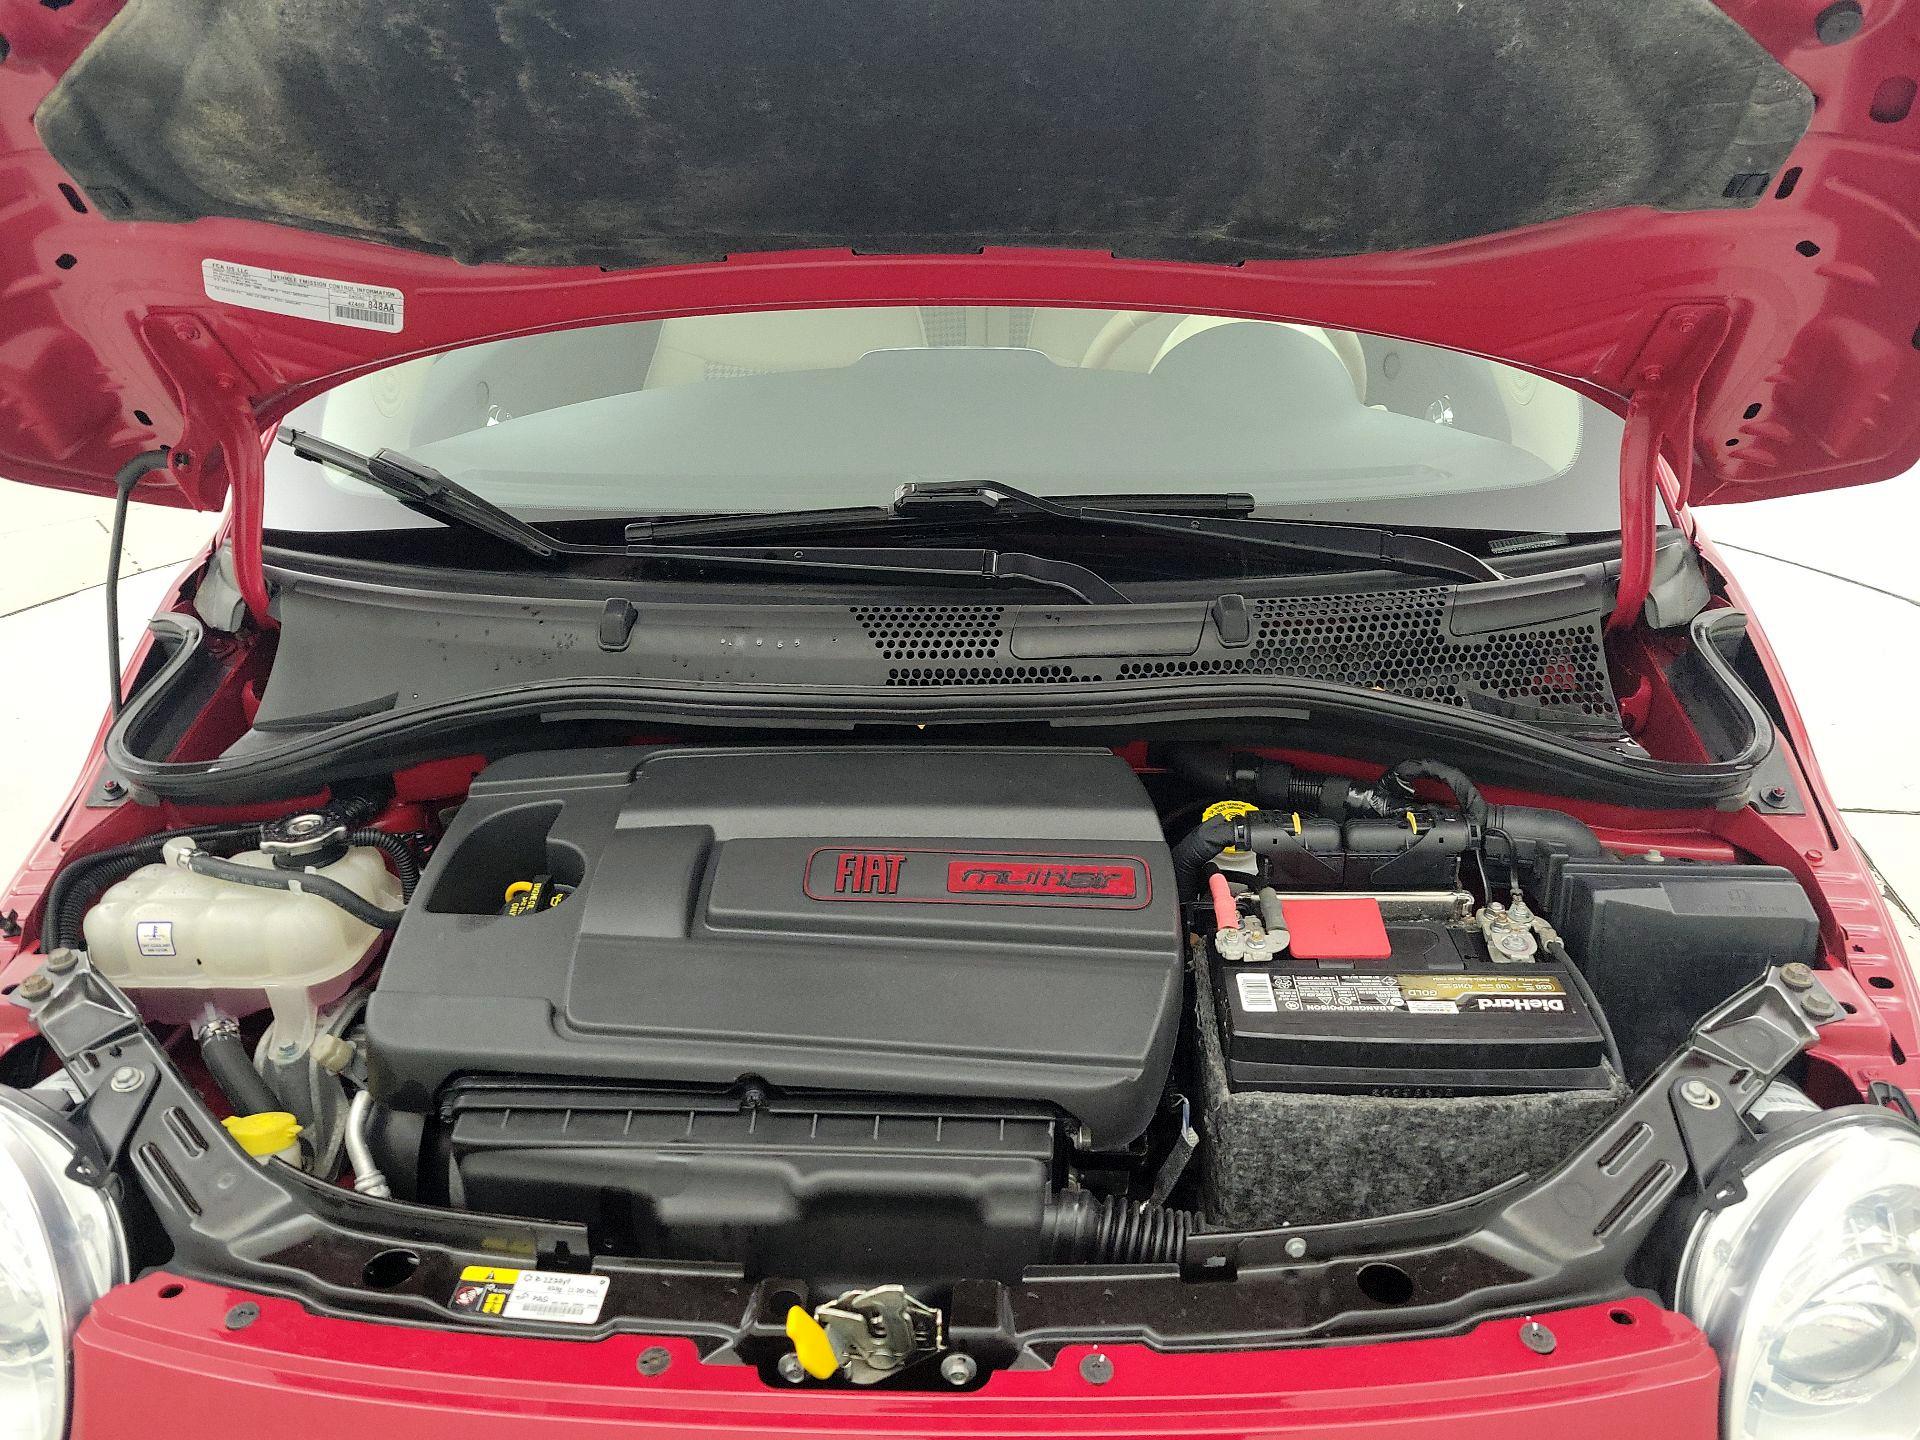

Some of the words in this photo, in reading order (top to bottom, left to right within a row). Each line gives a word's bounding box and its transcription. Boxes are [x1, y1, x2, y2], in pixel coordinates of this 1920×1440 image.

[299, 278, 327, 288] EMISSION
[328, 283, 355, 293] CONTROL
[356, 287, 395, 298] INFORMATION
[368, 300, 395, 313] 848AA
[834, 853, 907, 894] FIAT
[1477, 998, 1565, 1011] DieHard
